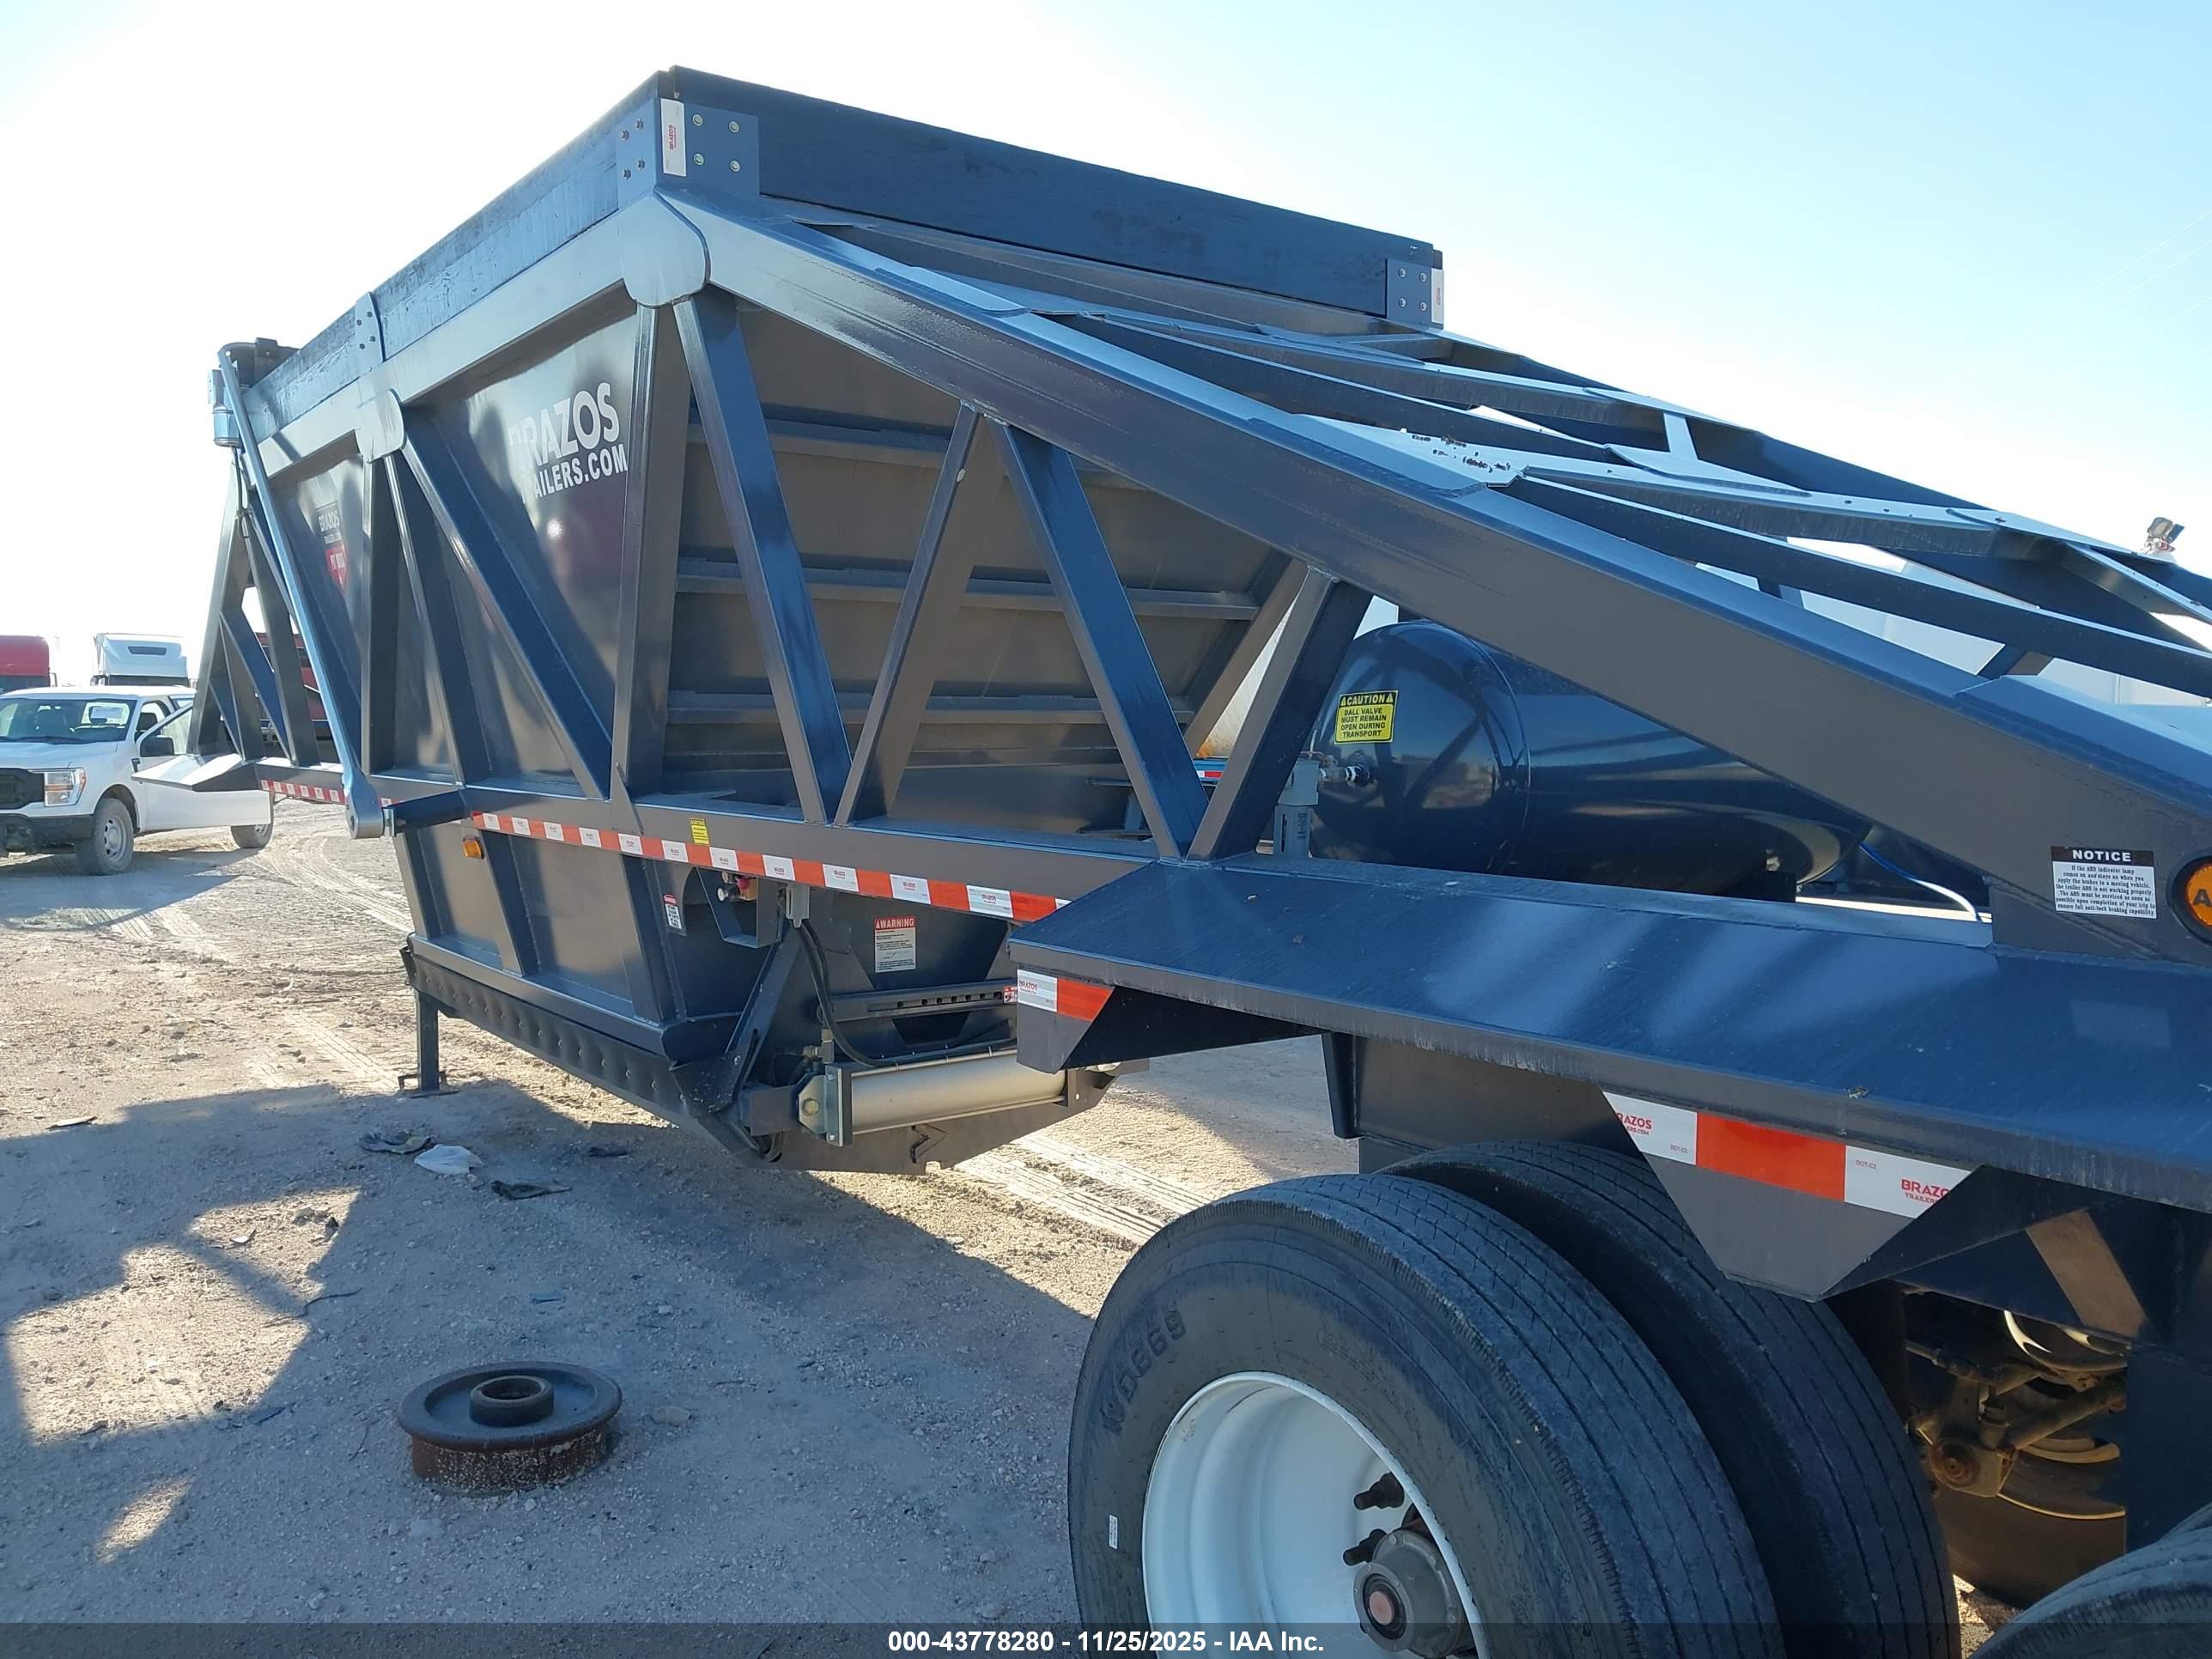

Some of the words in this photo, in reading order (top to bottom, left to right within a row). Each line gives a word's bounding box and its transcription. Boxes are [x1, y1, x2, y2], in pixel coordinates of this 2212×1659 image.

[524, 443, 629, 500] AILERS.COM
[1346, 694, 1385, 705] CAUTION
[1343, 730, 1382, 738] TRANSPORT
[2073, 849, 2131, 862] NOTICE
[879, 918, 915, 928] WARNING
[1855, 1159, 1877, 1170] DOT-C2
